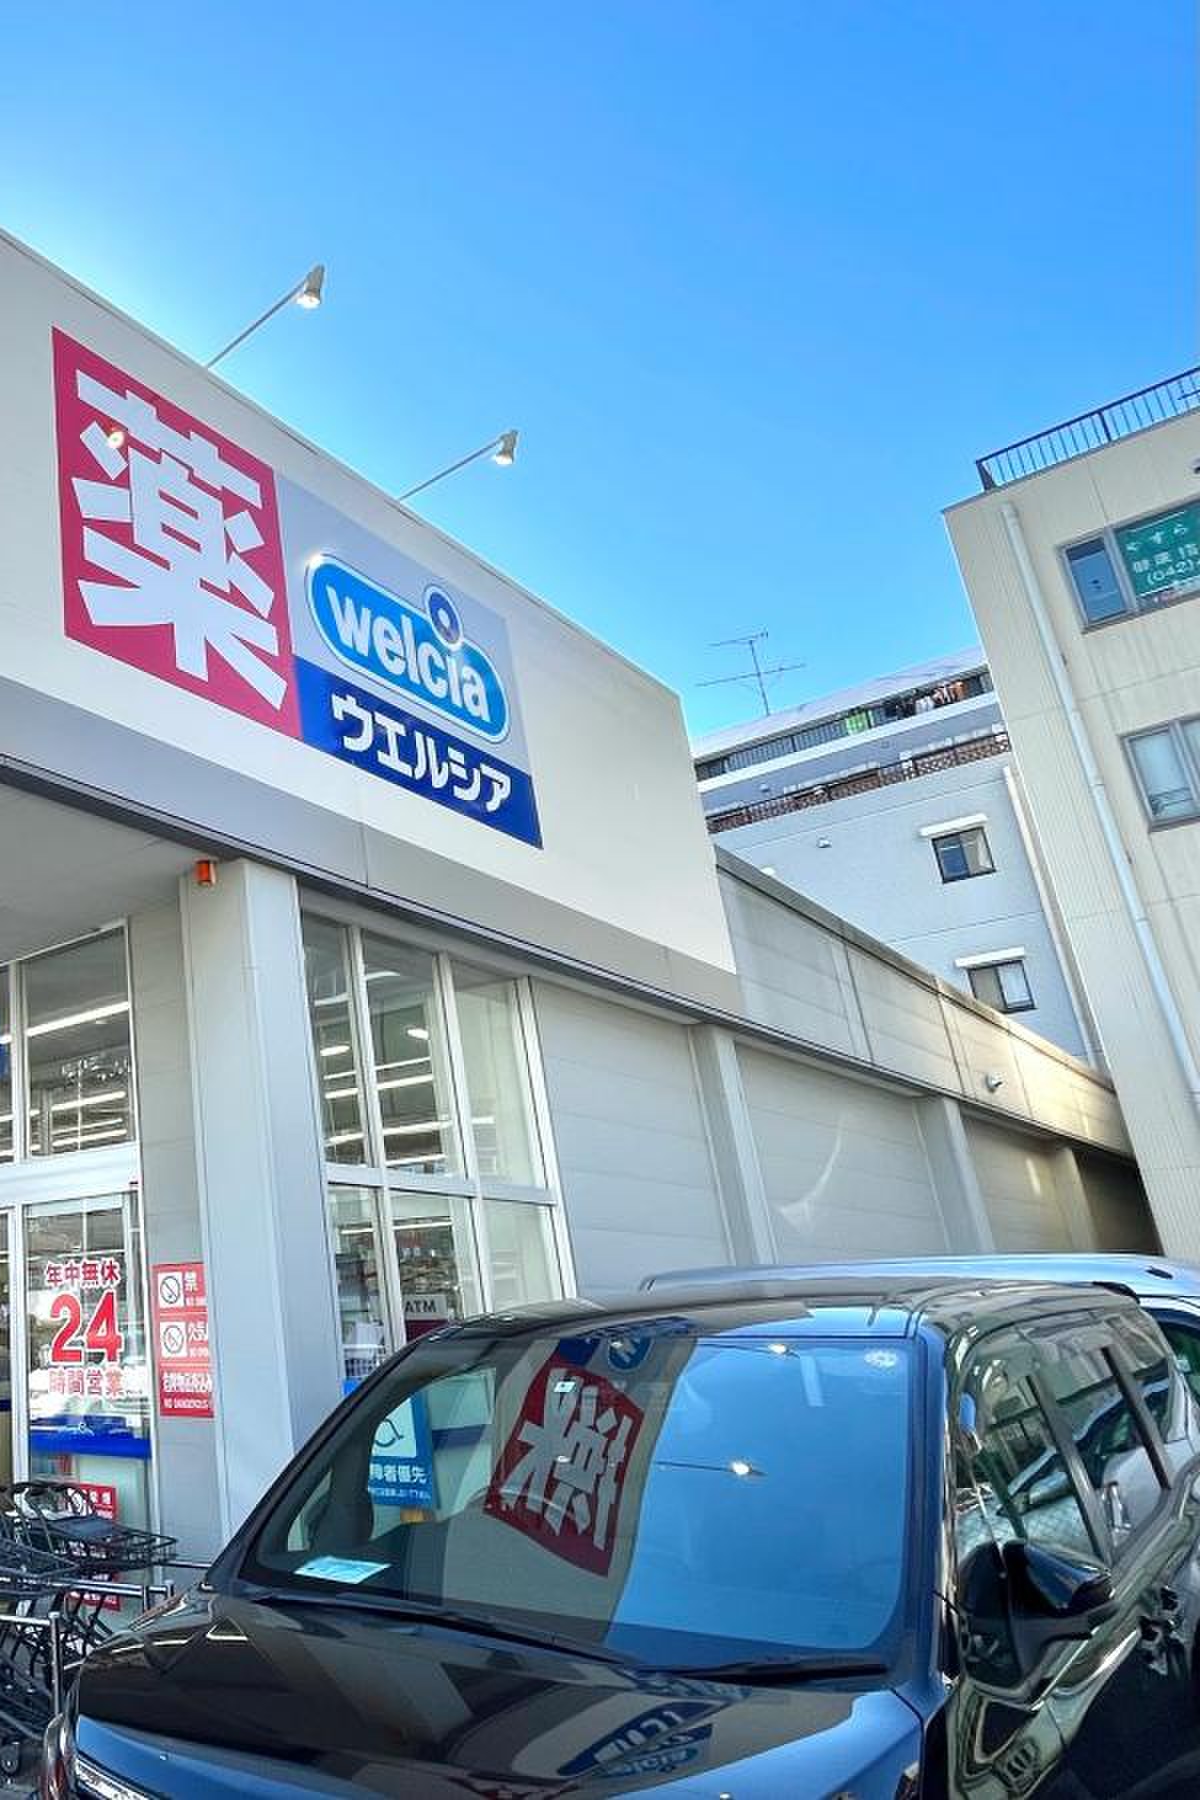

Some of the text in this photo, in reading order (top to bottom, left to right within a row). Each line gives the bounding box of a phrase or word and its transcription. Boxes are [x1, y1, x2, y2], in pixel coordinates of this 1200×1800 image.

[71, 369, 287, 711] 薬
[327, 584, 490, 724] welcia
[331, 693, 511, 811] ウエルシア
[47, 1260, 119, 1285] 年中無休
[405, 1300, 437, 1313] ATM
[50, 1291, 122, 1363] 24
[48, 1369, 123, 1396] 時間営業
